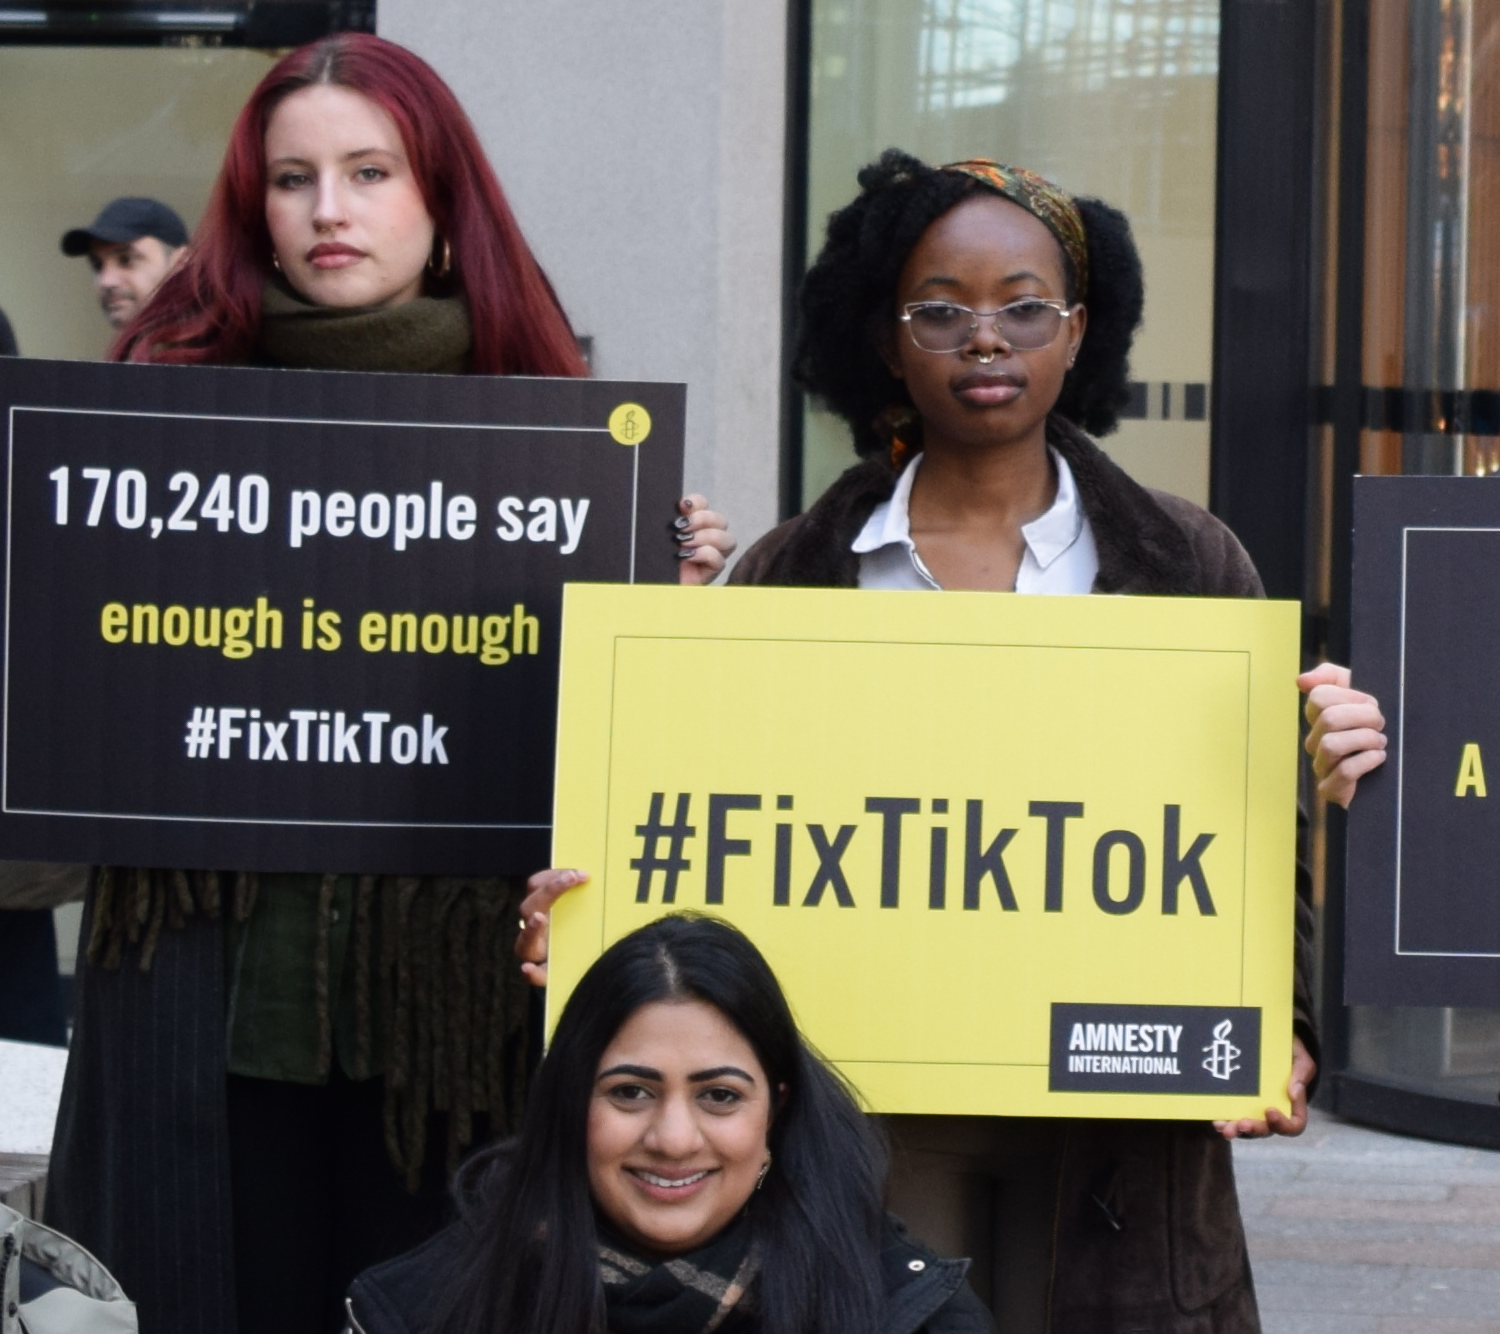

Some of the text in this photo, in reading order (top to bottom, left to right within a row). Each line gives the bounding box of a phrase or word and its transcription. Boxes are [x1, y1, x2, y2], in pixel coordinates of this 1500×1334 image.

[49, 466, 591, 555] 170,240 people say
[101, 596, 539, 665] enough is enough
[184, 706, 449, 765] #FixTikTok
[1455, 743, 1487, 798] A
[629, 791, 1217, 917] #FixTikTok
[1068, 1055, 1182, 1075] INTERNATIONAL
[1069, 1022, 1183, 1053] AMNESTY
